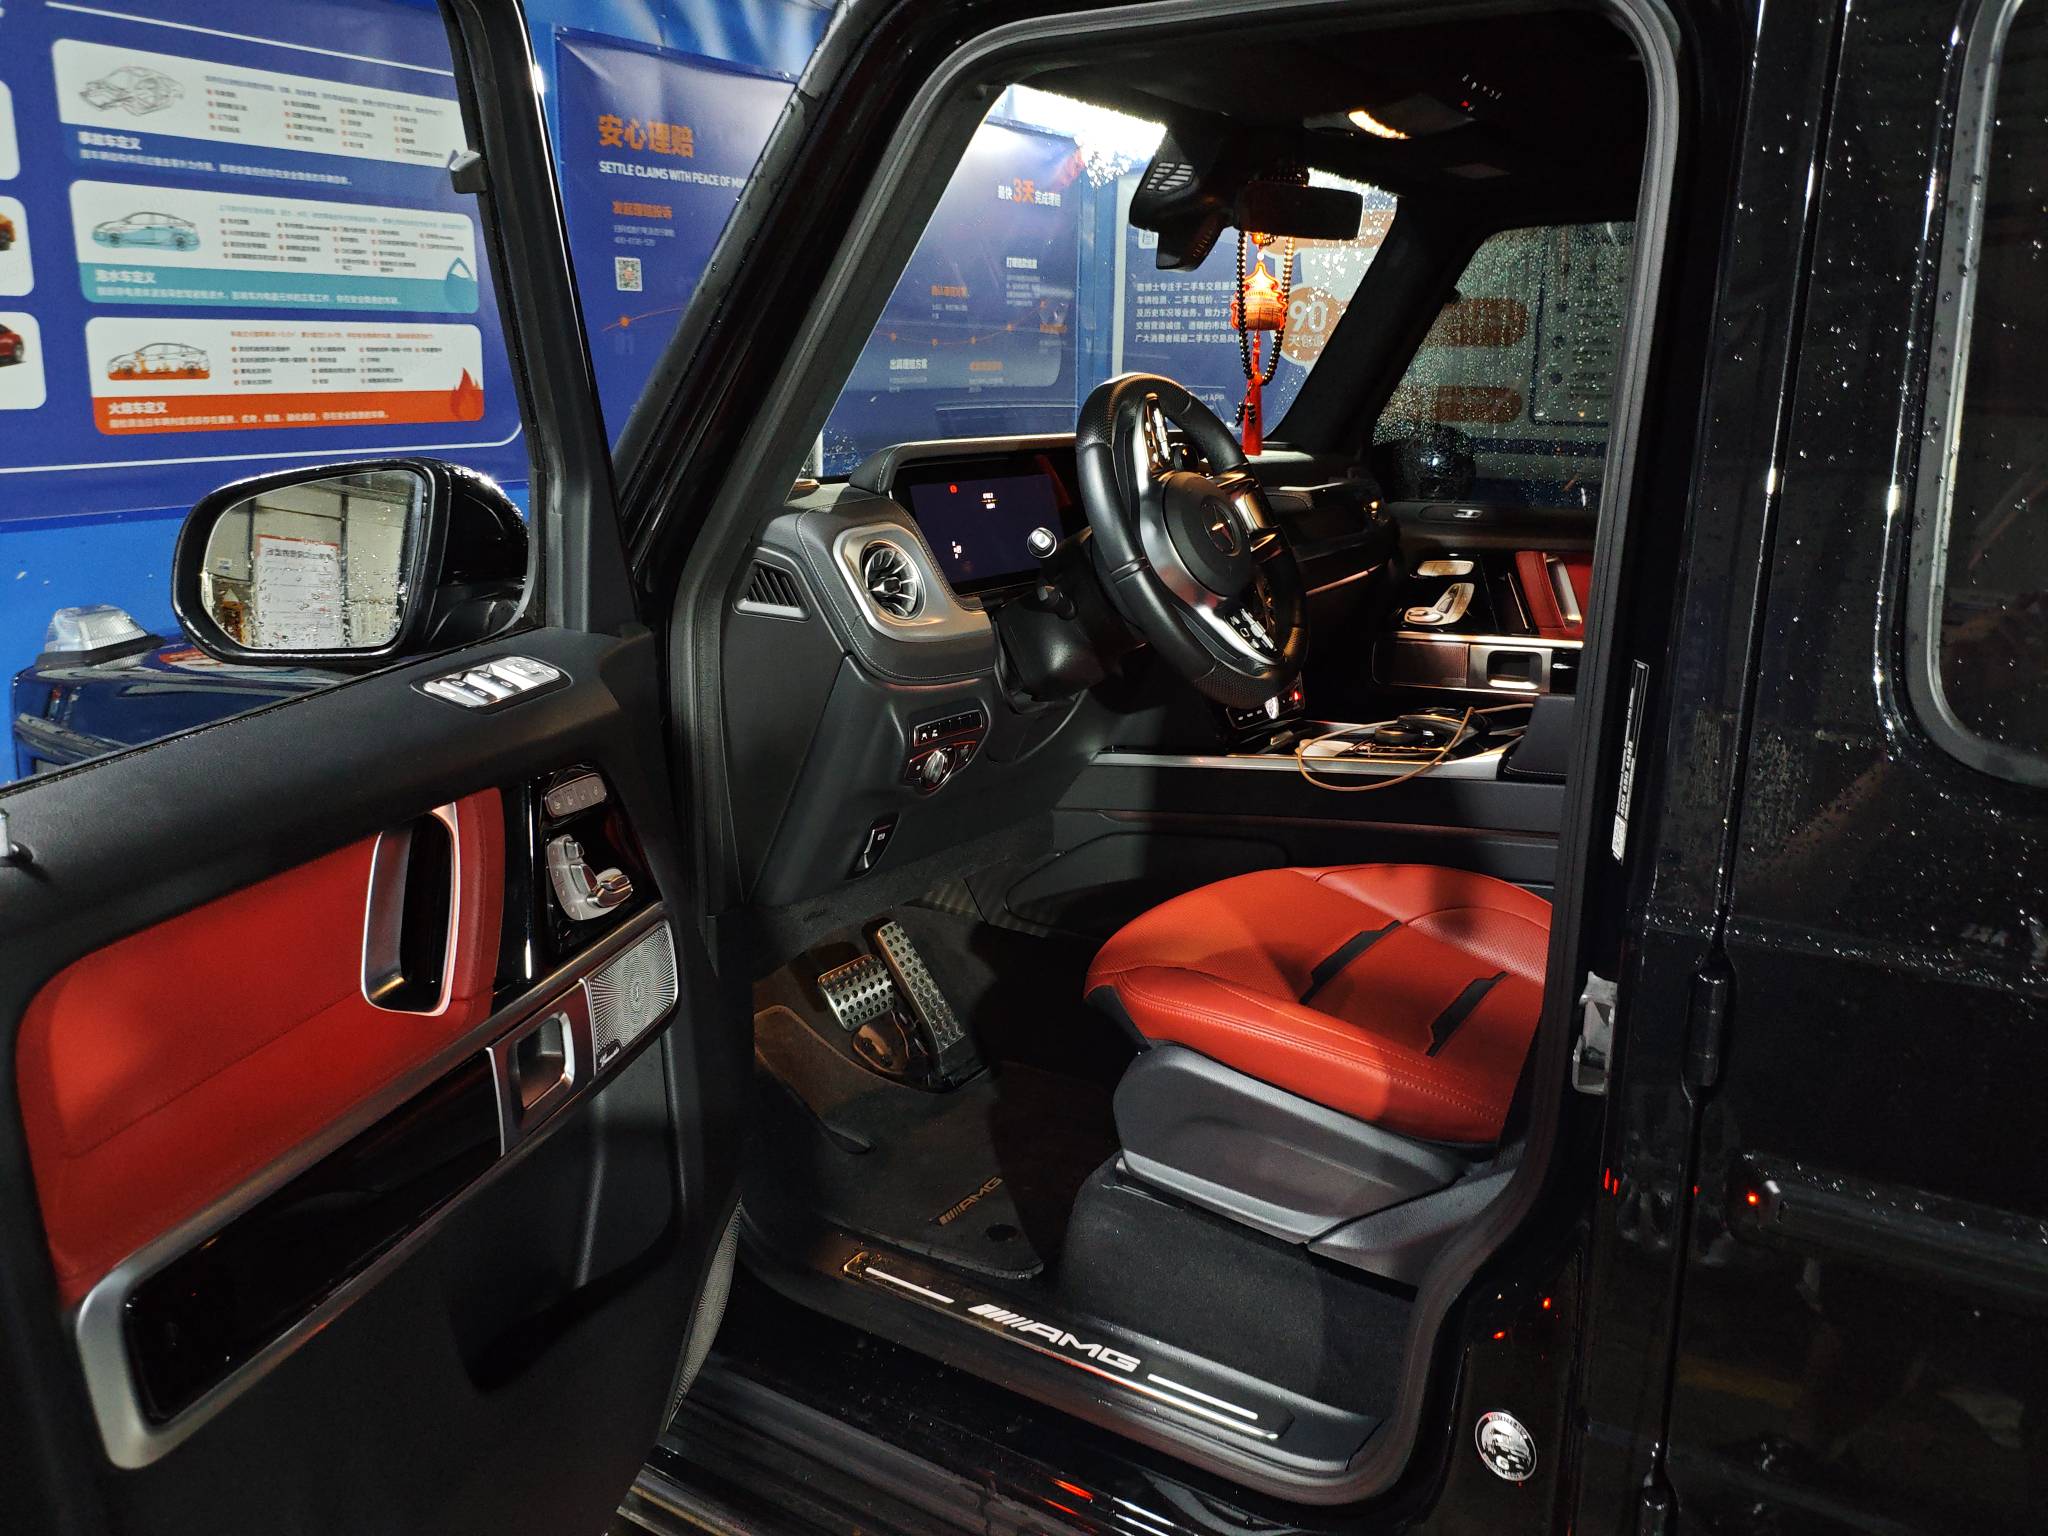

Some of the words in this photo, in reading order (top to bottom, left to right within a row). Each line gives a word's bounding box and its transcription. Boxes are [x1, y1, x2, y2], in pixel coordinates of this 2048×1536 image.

[599, 160, 634, 176] SETTLE
[635, 165, 668, 180] CLAIMS
[668, 169, 691, 183] WITH
[692, 171, 720, 186] PEACE
[720, 175, 731, 187] OF
[1289, 300, 1327, 333] 90
